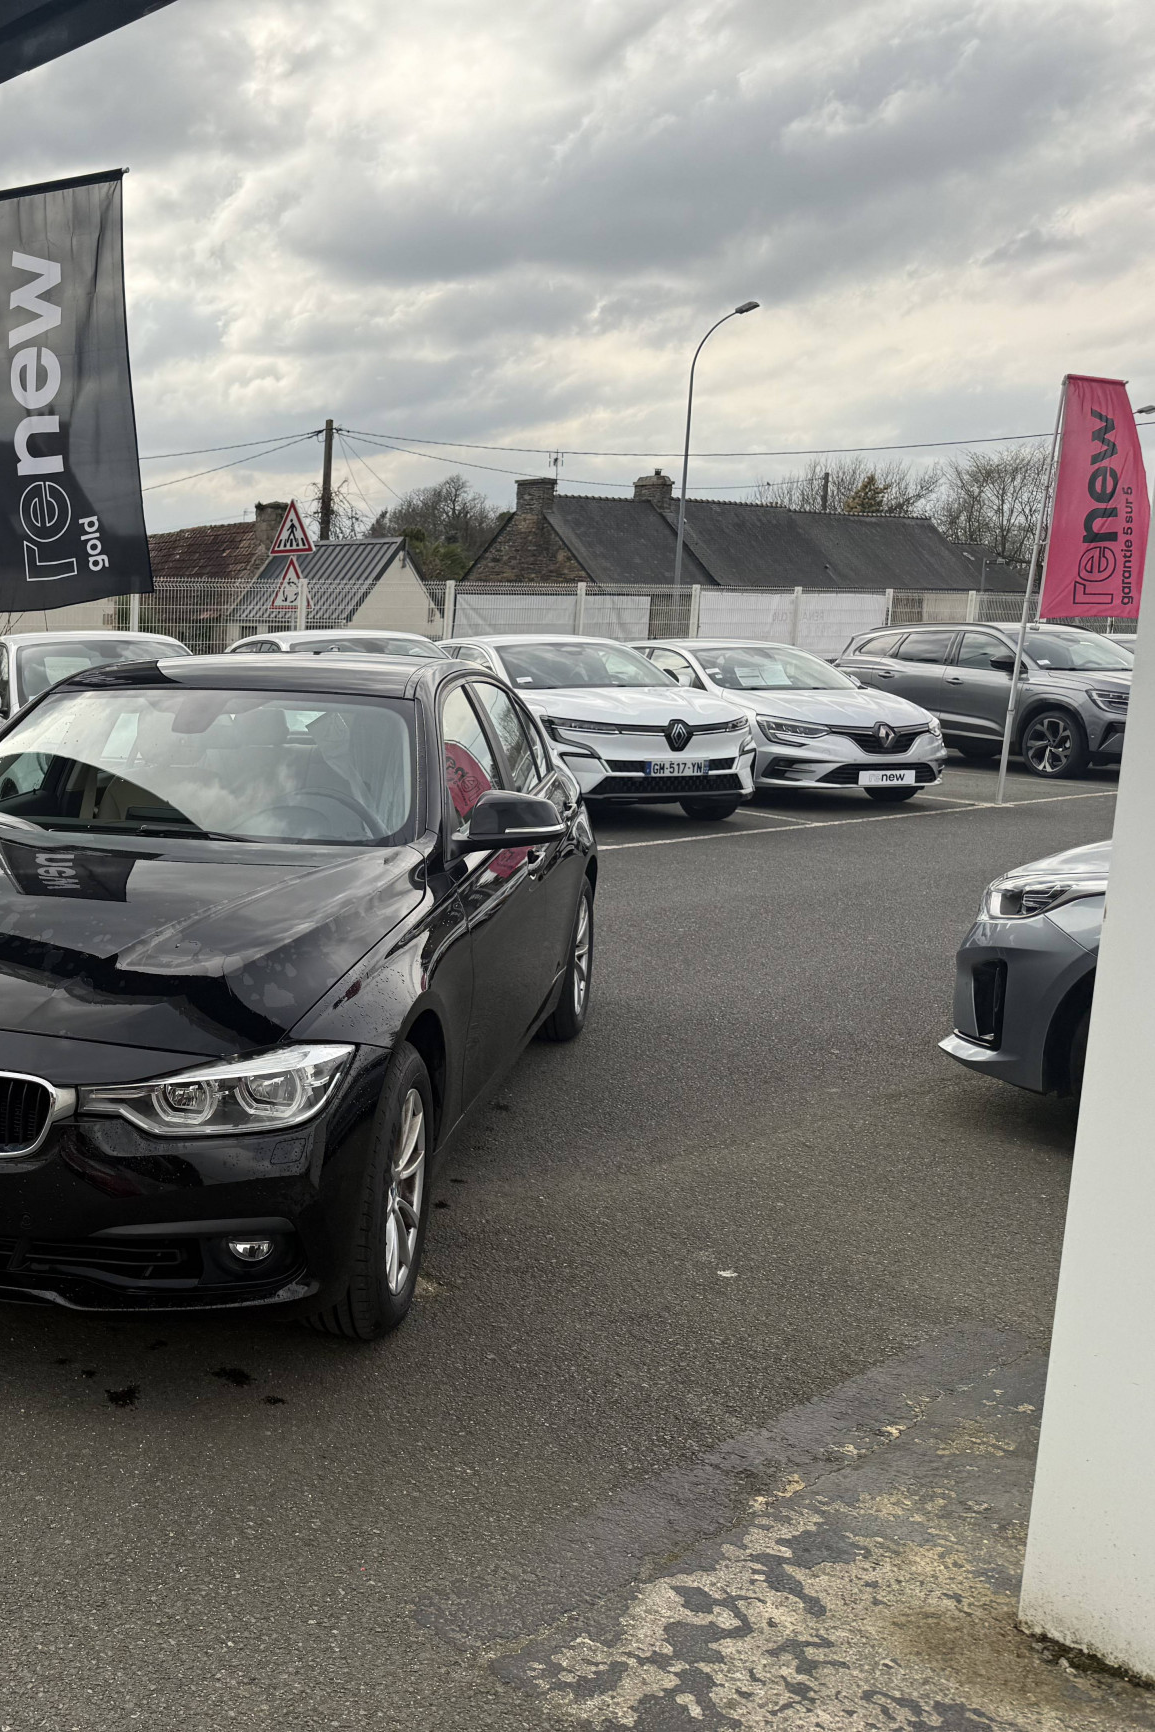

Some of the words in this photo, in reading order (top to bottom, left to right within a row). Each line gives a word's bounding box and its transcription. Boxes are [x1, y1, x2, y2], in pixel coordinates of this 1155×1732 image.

[8, 250, 78, 582] renew
[1073, 407, 1119, 605] renew
[1122, 486, 1133, 496] 5
[1123, 527, 1133, 536] 5
[1125, 501, 1133, 524] sur
[78, 515, 109, 572] gold
[1121, 540, 1133, 605] garantie
[868, 773, 906, 783] renew
